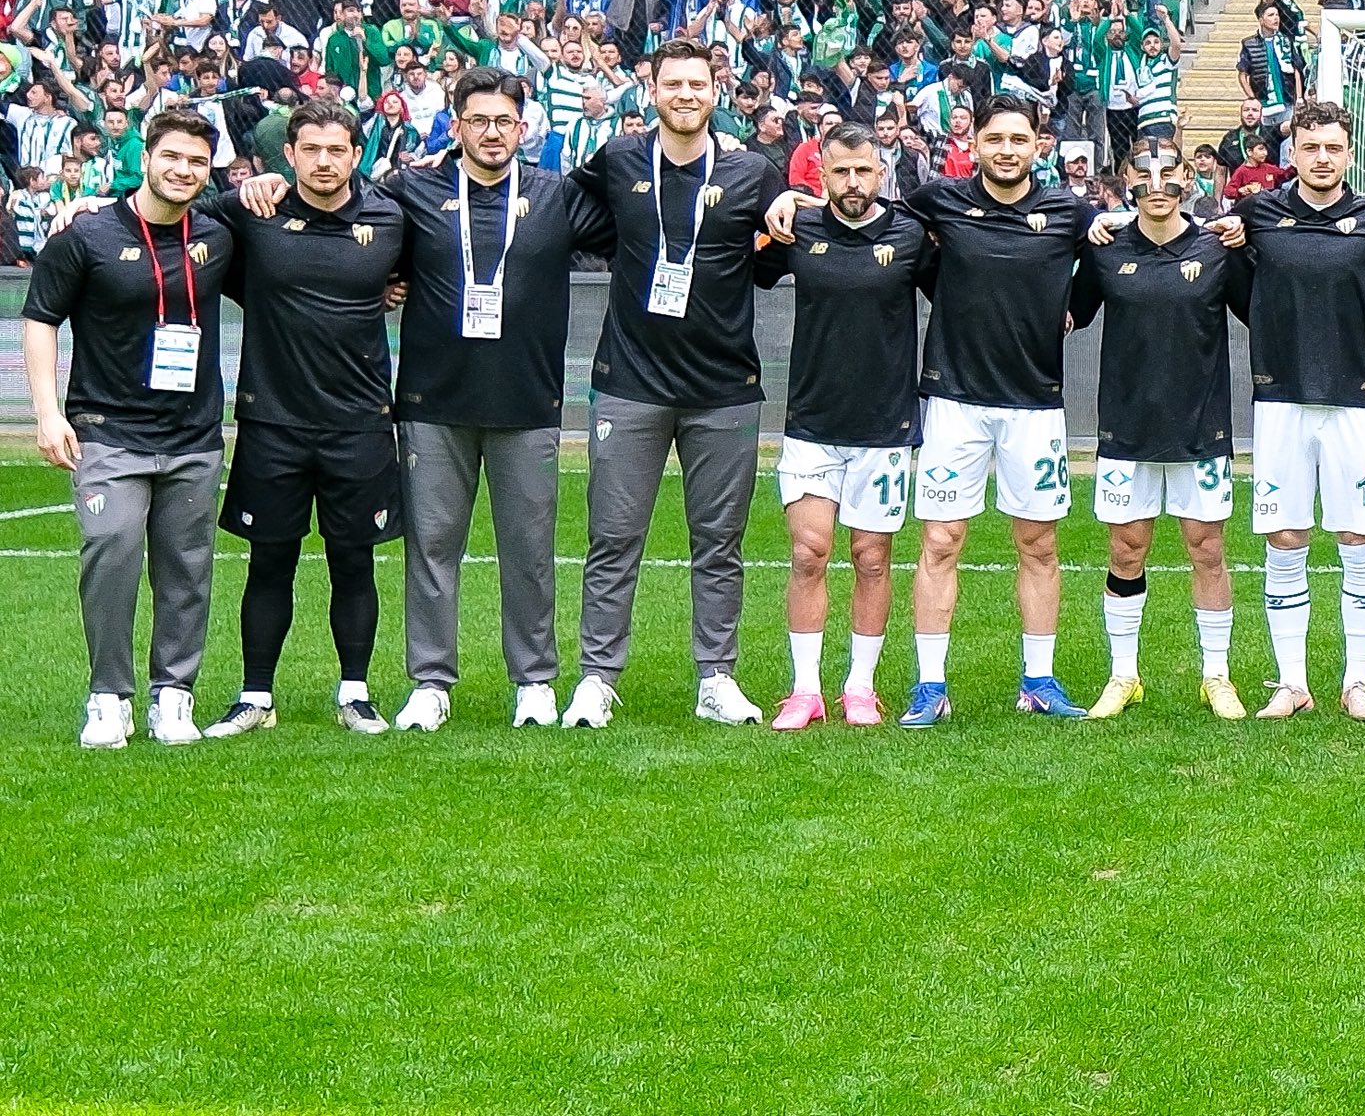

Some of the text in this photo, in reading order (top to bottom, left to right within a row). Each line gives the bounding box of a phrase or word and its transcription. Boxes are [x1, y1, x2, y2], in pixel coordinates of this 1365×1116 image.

[1034, 457, 1068, 492] 26
[874, 473, 909, 504] 11
[922, 485, 956, 502] Togg
[1102, 490, 1130, 506] Togg
[1254, 500, 1278, 516] ogg
